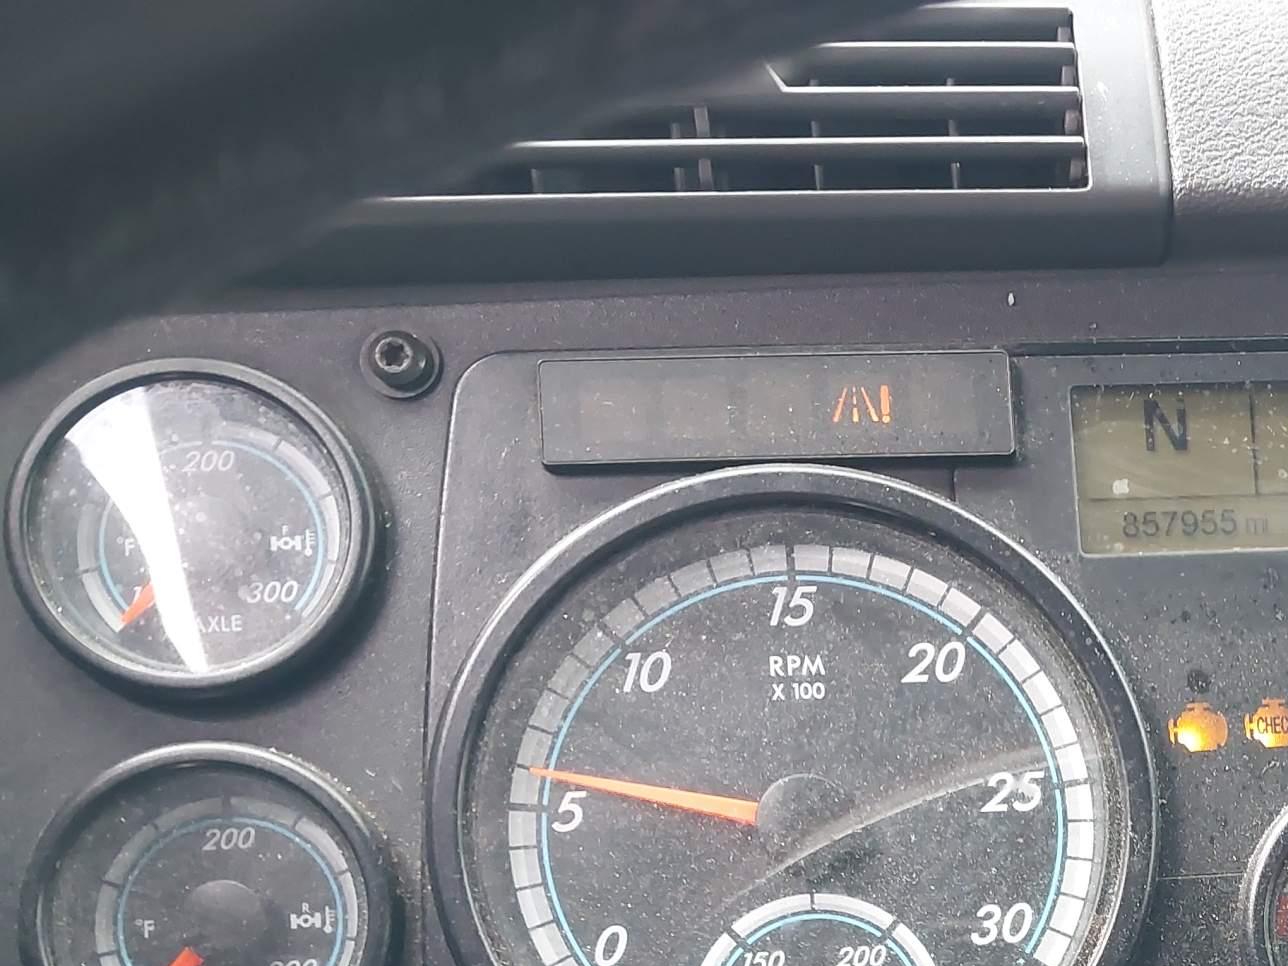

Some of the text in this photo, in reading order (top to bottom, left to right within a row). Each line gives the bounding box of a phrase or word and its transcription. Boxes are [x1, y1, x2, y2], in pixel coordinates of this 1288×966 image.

[1143, 397, 1188, 451] N
[182, 451, 235, 472] 200
[1122, 508, 1237, 538] 857955
[247, 580, 298, 604] 300
[769, 585, 817, 627] 15
[622, 651, 672, 693] 10
[769, 655, 826, 677] RPM
[901, 641, 966, 684] 20
[771, 682, 826, 701] X 100
[551, 791, 588, 833] 5
[980, 770, 1046, 813] 25
[202, 828, 255, 851] 200
[970, 902, 1033, 946] 30
